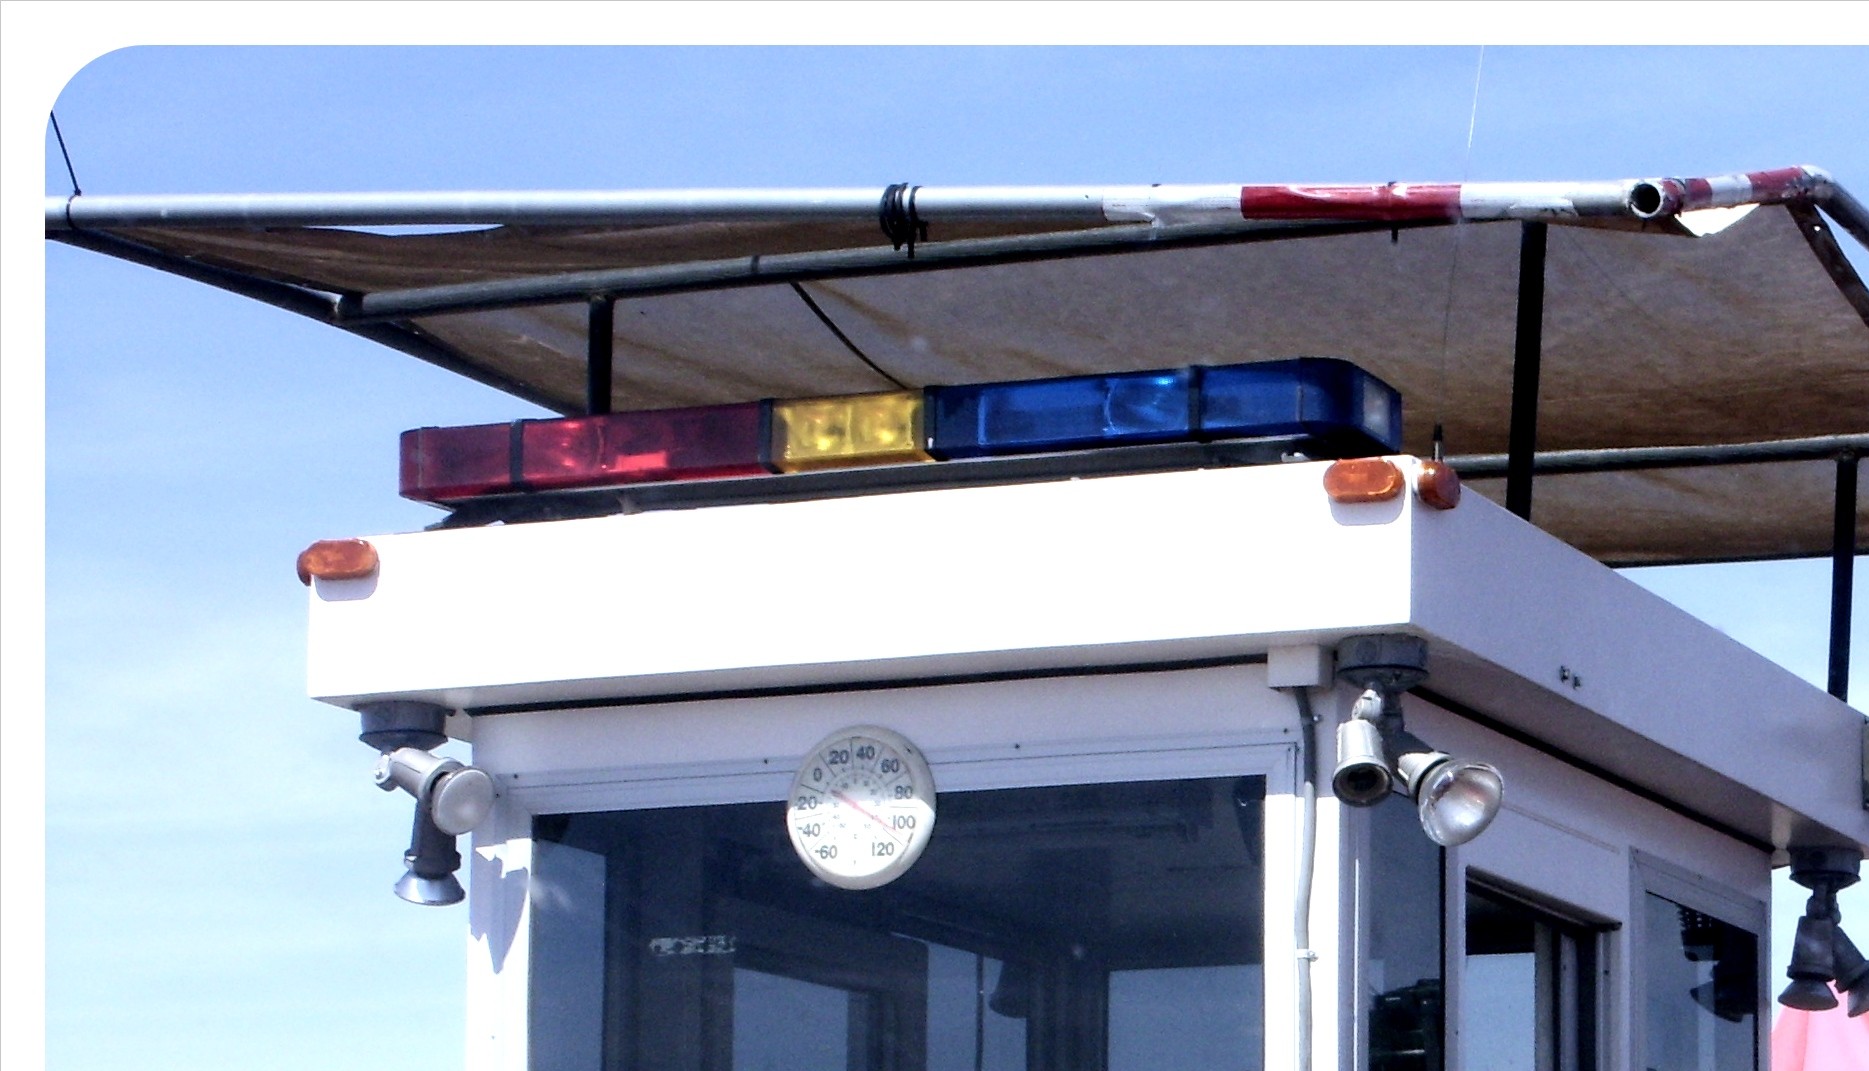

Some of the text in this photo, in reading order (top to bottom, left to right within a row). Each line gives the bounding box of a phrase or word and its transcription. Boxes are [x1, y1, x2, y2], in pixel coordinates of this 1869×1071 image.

[829, 750, 849, 765] 20
[856, 745, 875, 760] 40
[881, 758, 899, 773] 60
[813, 768, 822, 782] 0
[895, 785, 913, 800] 80
[893, 815, 916, 829] 100
[871, 842, 895, 857] 120
